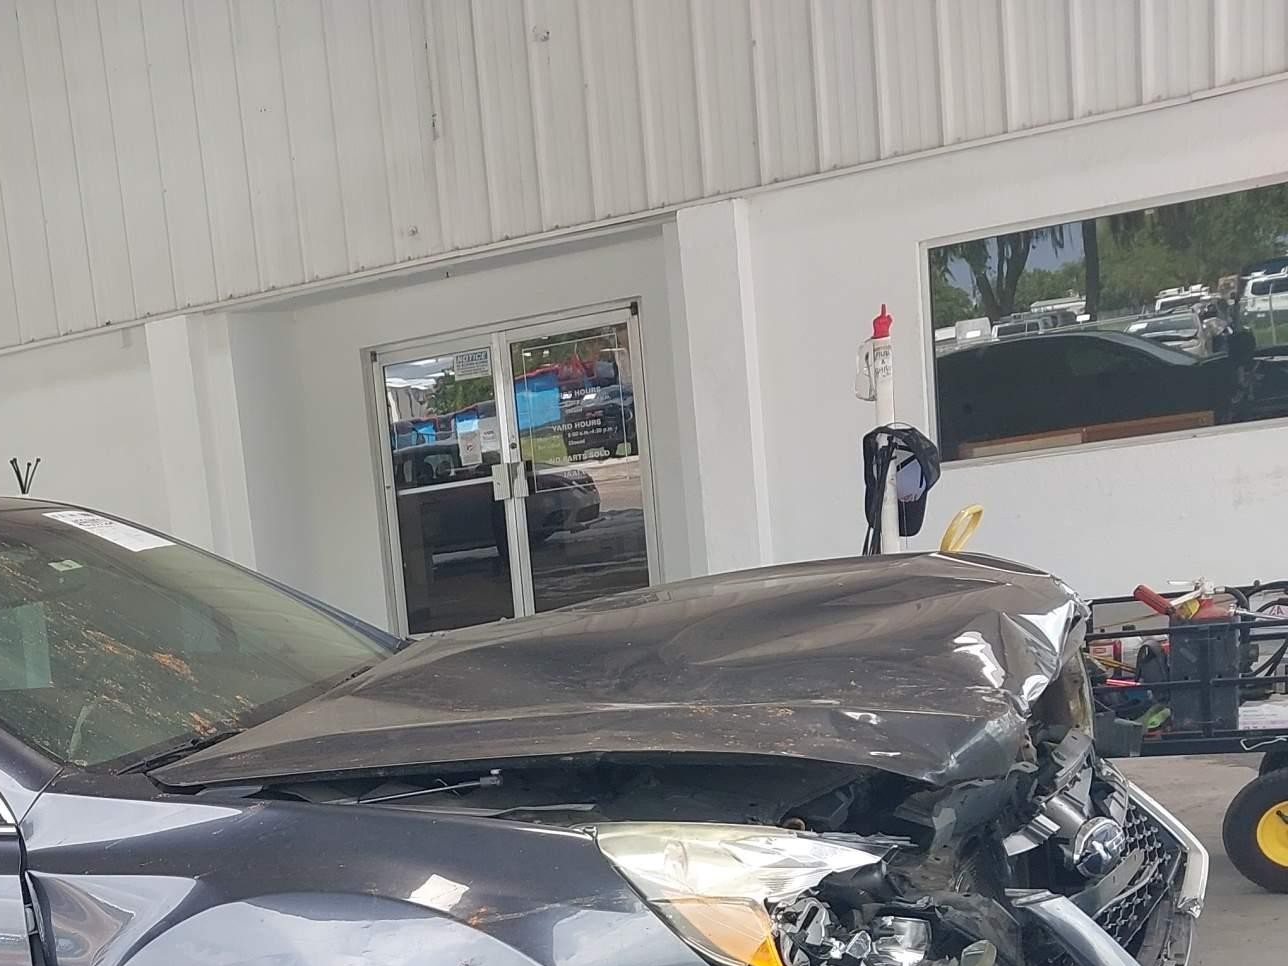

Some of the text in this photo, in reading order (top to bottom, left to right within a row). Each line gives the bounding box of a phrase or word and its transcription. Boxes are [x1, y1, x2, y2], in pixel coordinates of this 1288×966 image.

[456, 351, 488, 362] NOTICE
[552, 419, 602, 432] YARD HOURS
[589, 449, 611, 459] SOLD
